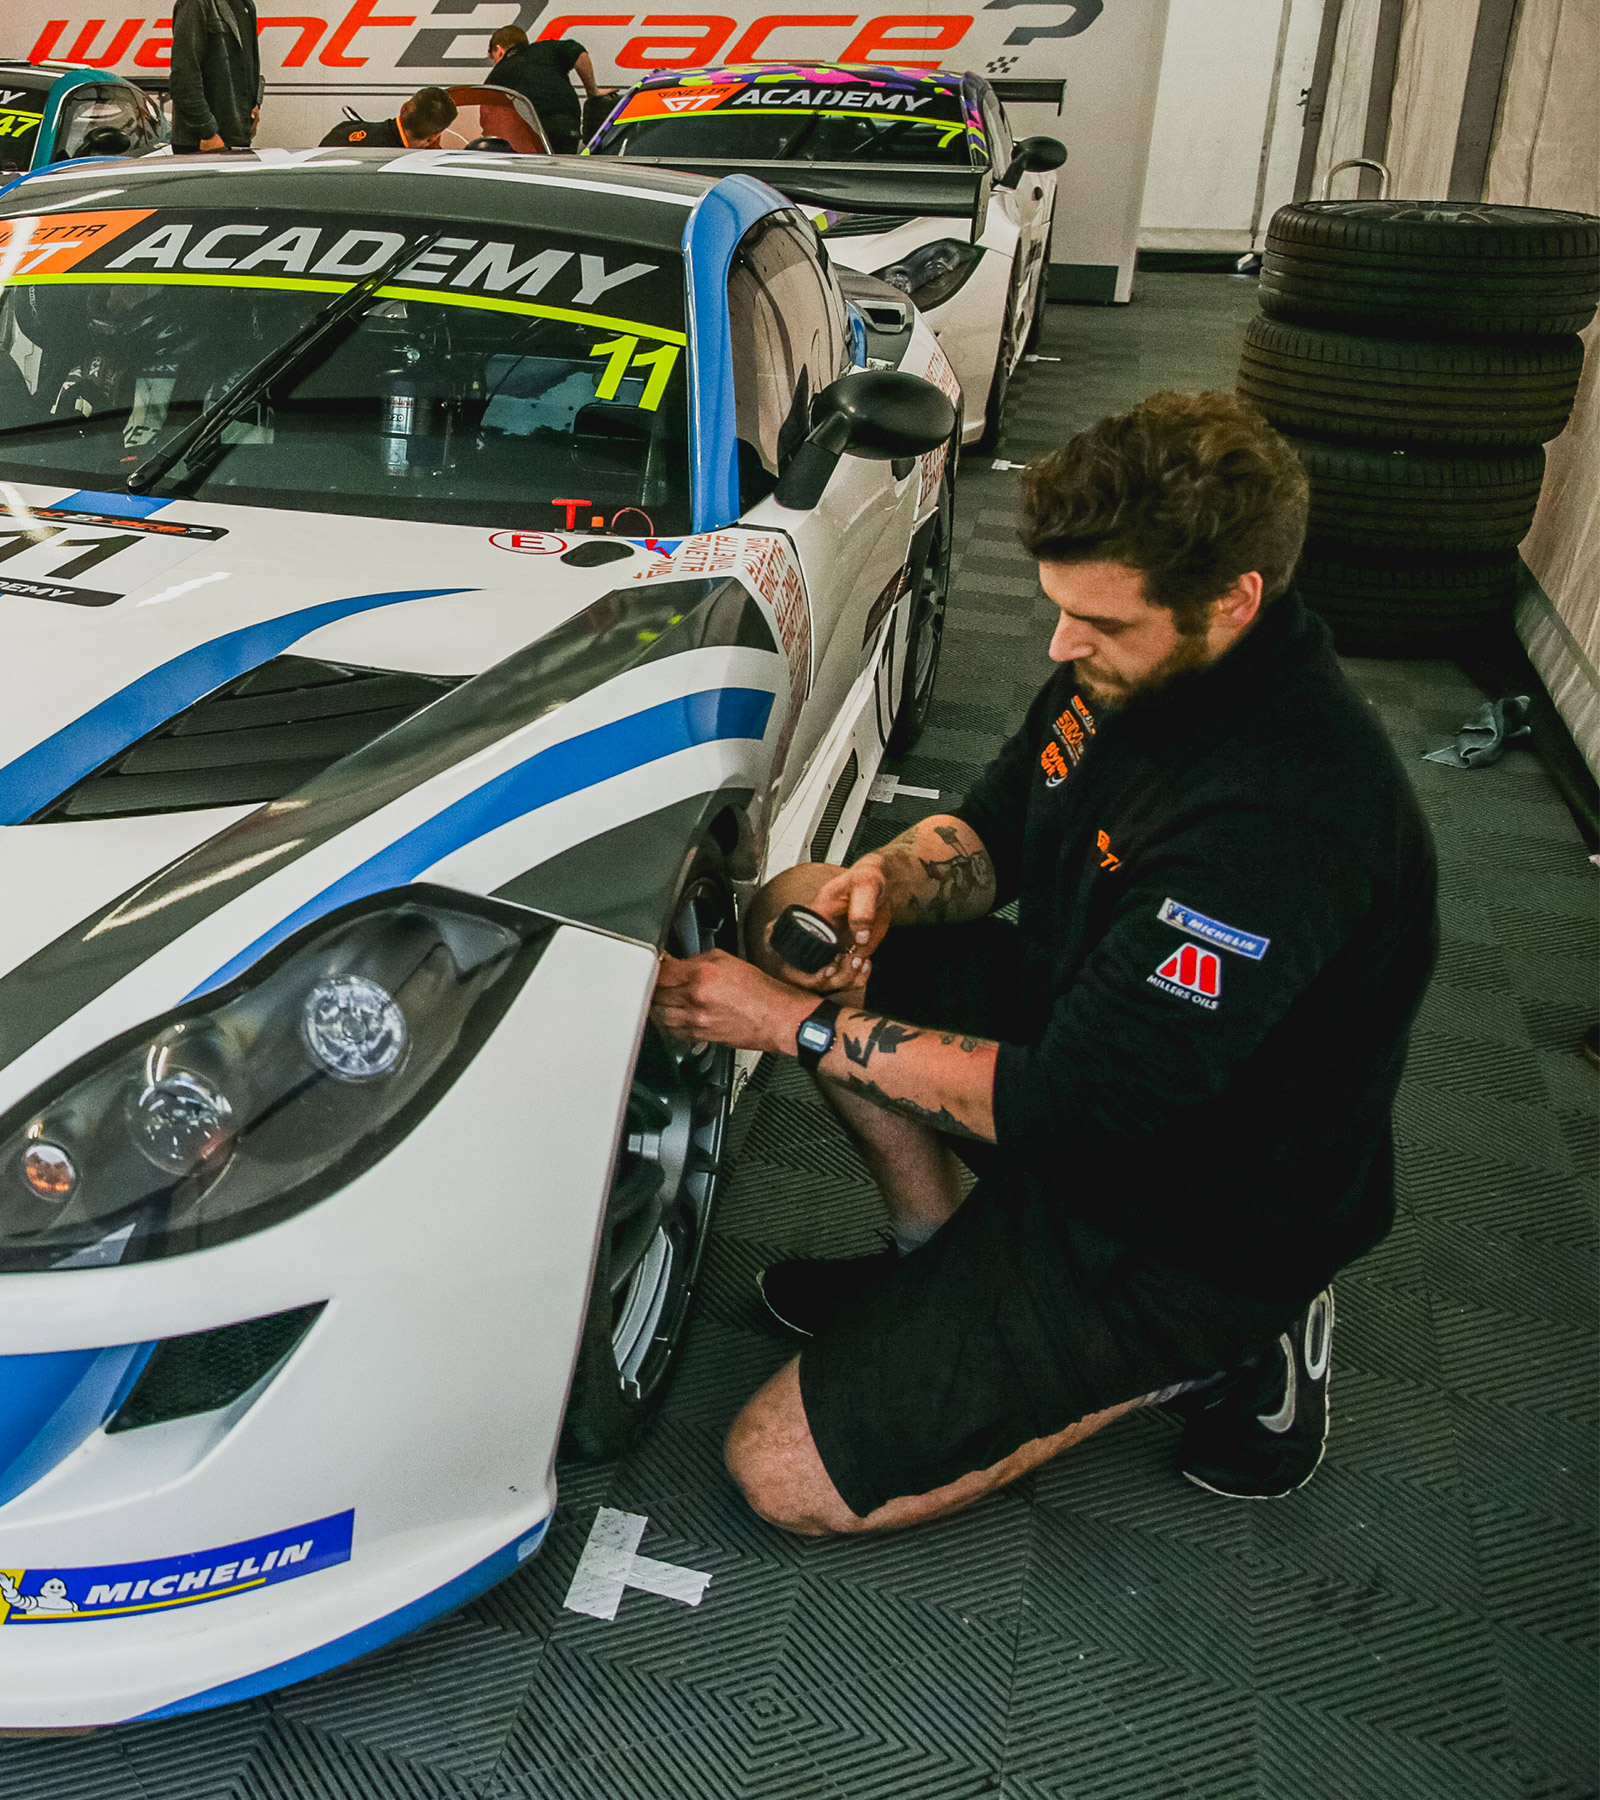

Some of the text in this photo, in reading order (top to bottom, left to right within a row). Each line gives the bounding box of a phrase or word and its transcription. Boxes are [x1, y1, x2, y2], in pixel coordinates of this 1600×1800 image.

[661, 88, 932, 112] GT ACADEMY
[936, 125, 963, 149] 7
[104, 224, 659, 306] ACADEMY
[589, 333, 681, 412] 11
[1188, 918, 1258, 951] MICHELIN
[1146, 975, 1219, 1011] MILLERS OILS
[82, 1539, 314, 1606] MICHELIN
